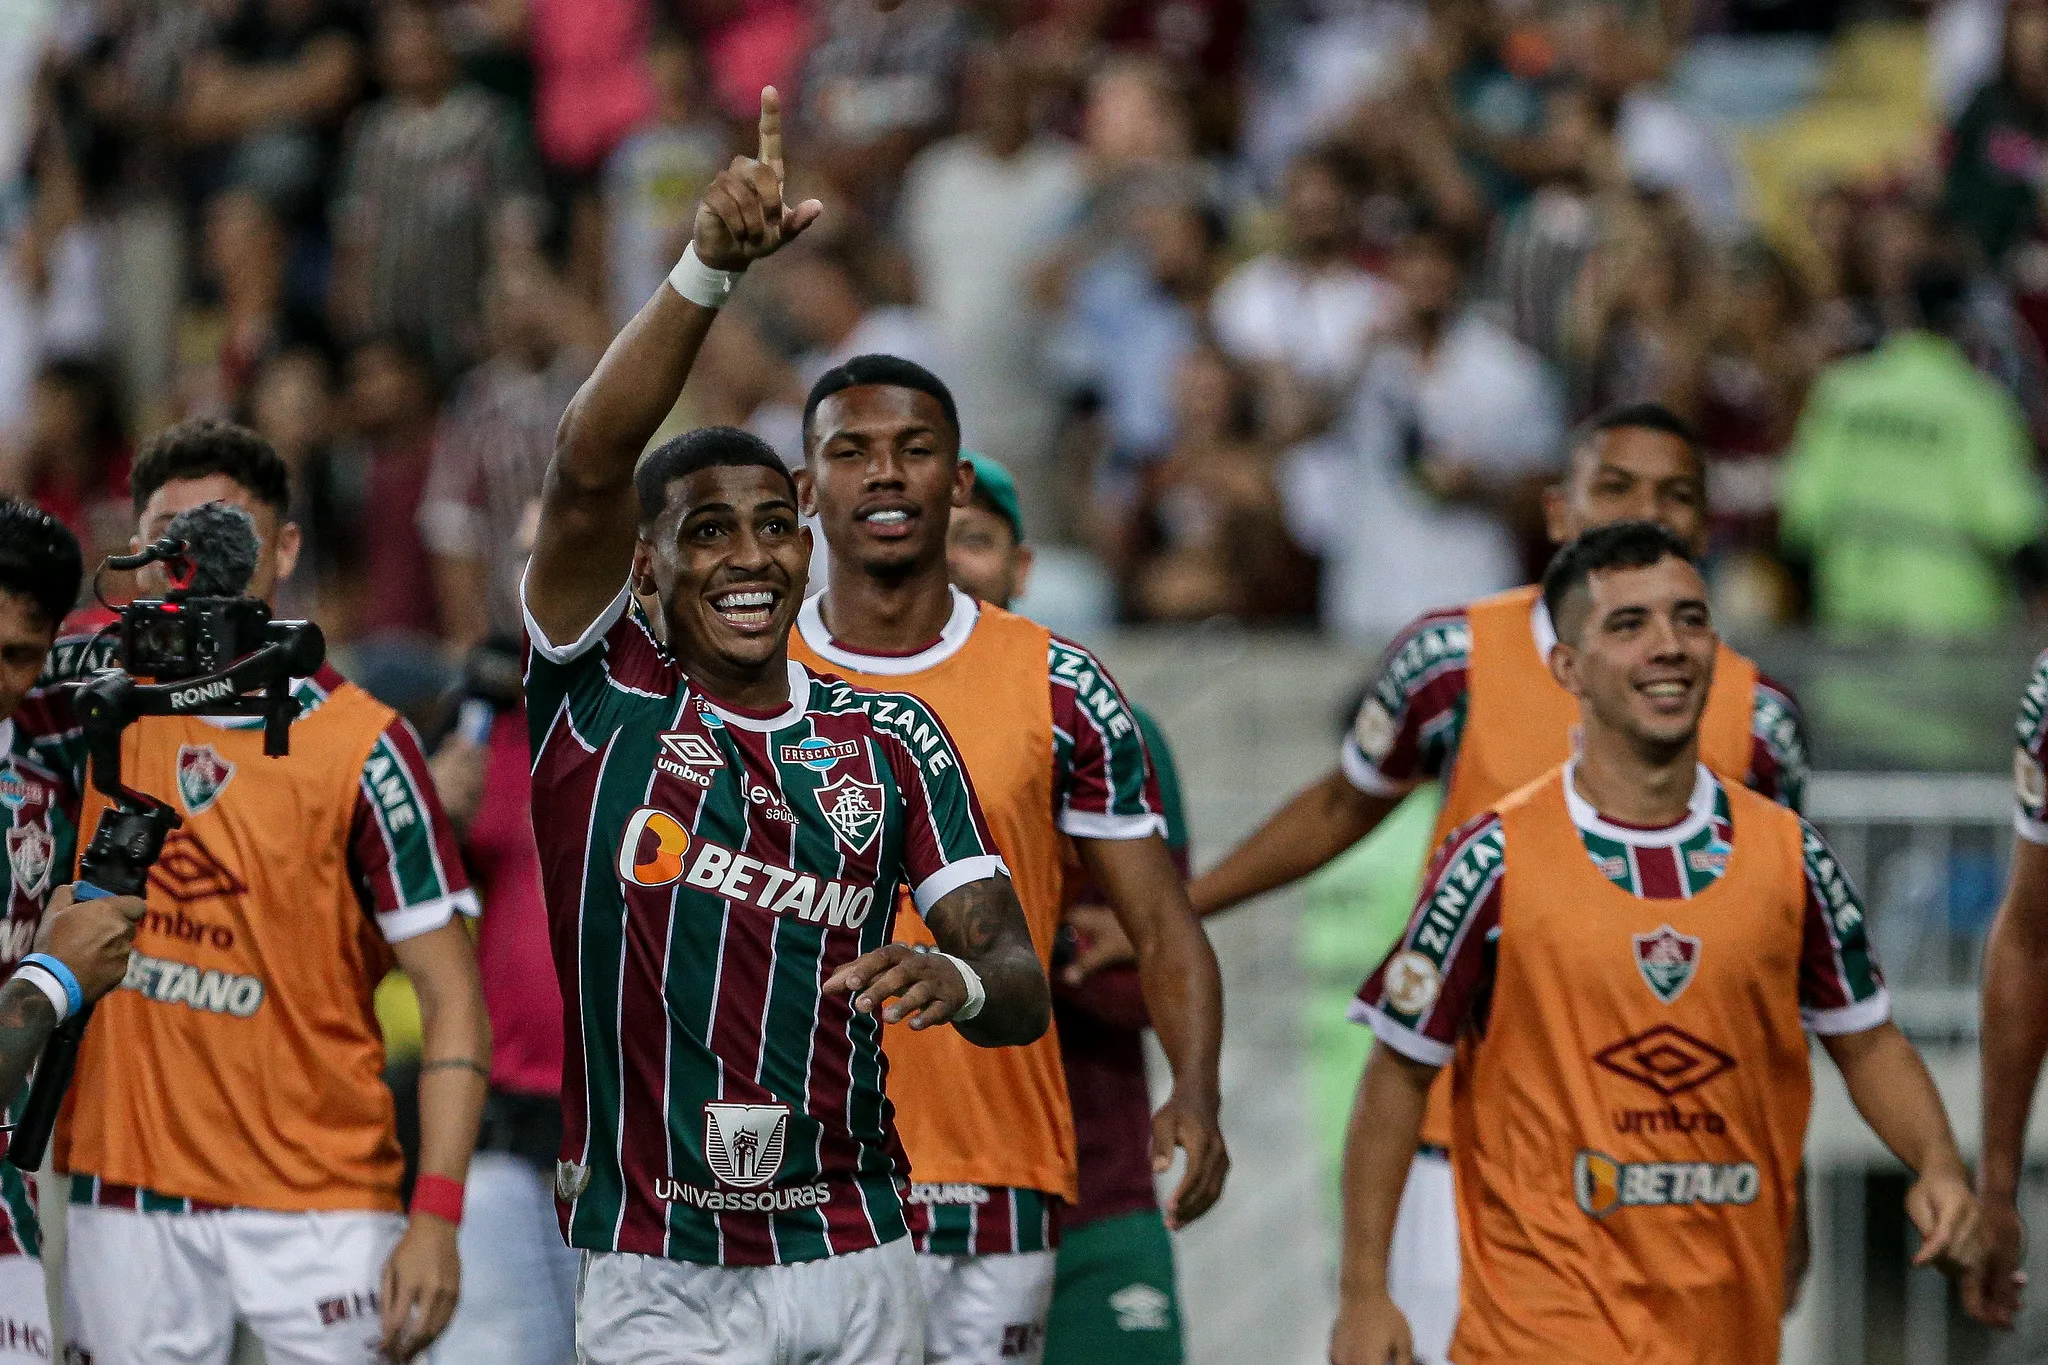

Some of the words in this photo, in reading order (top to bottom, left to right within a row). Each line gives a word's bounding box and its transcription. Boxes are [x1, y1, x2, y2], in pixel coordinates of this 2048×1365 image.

[170, 678, 234, 709] RONIN
[785, 744, 852, 760] FRESCATTO
[657, 757, 710, 787] umbro
[686, 843, 875, 929] BETANO
